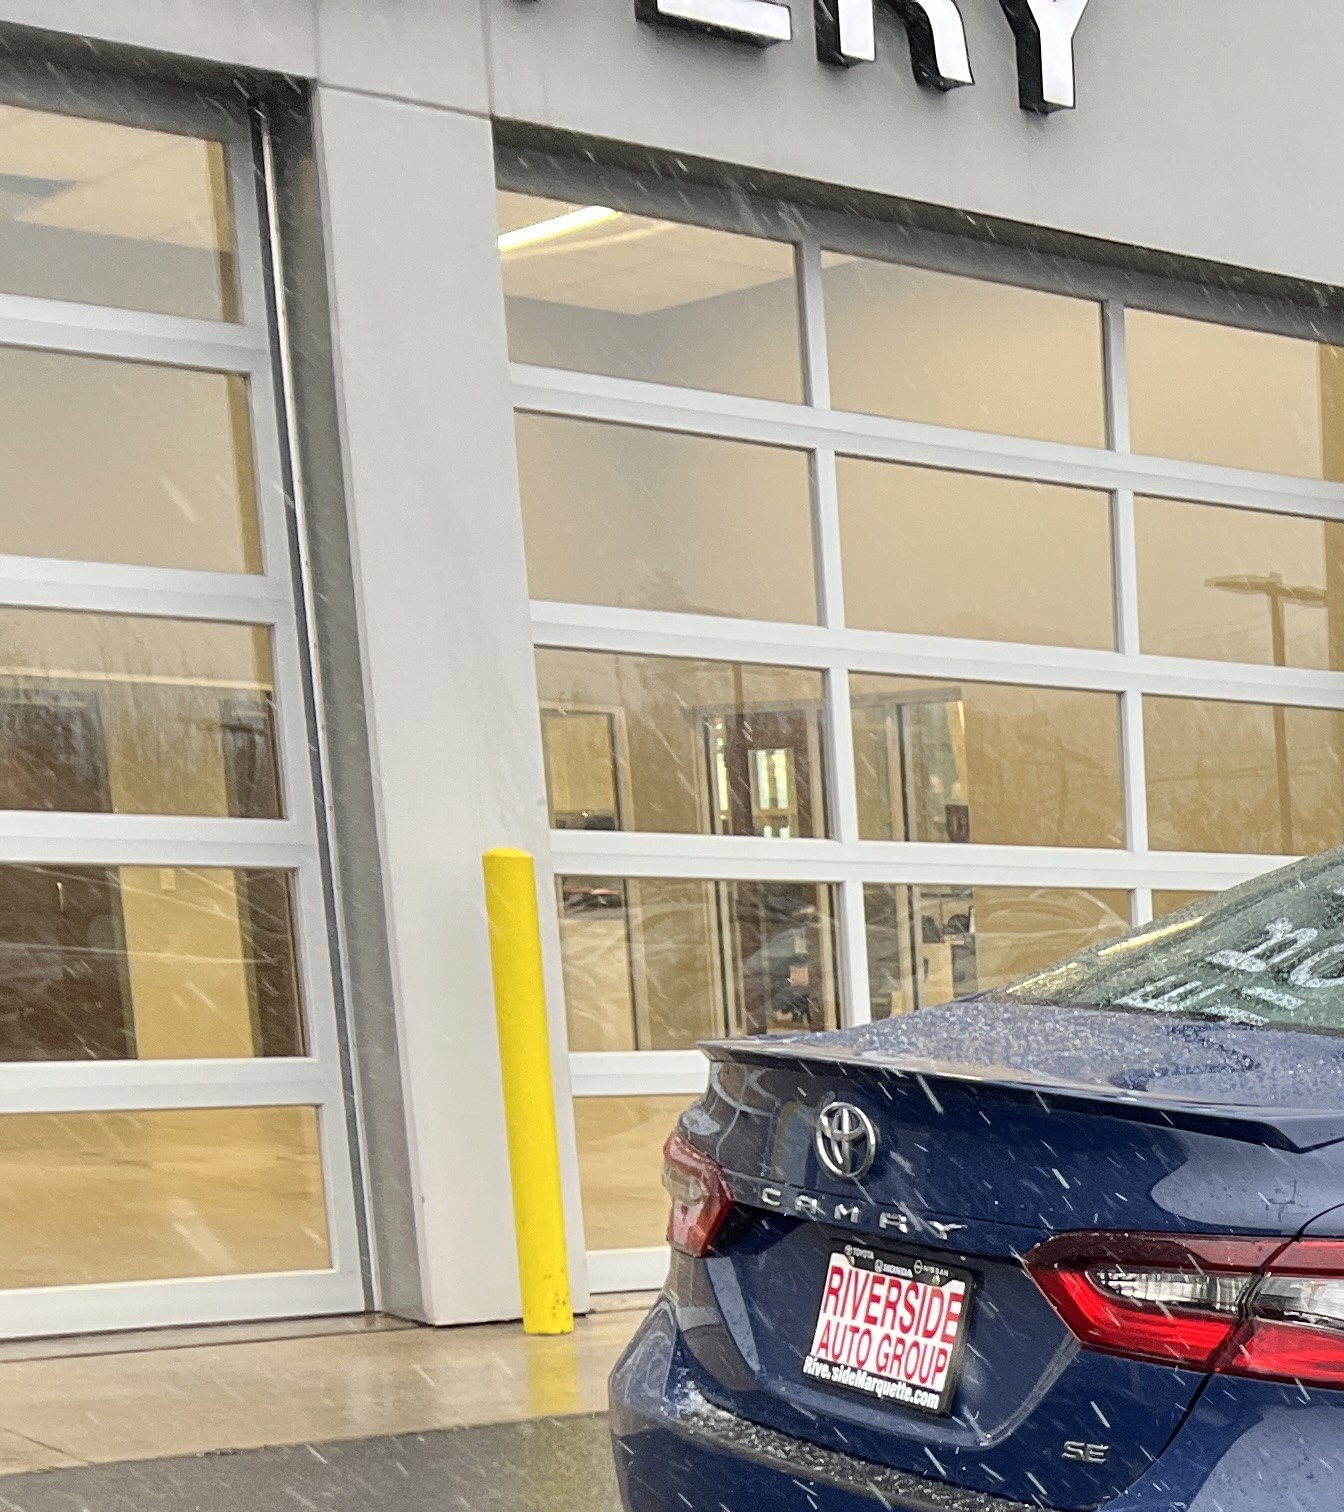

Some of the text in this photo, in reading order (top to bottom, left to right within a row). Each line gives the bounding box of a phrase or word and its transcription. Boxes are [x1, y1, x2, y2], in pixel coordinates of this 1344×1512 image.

[761, 1187, 967, 1241] CAMRY
[823, 1265, 965, 1345] RIVERSIDE
[815, 1319, 949, 1386] AUTO GROUP
[1061, 1440, 1109, 1464] SE
